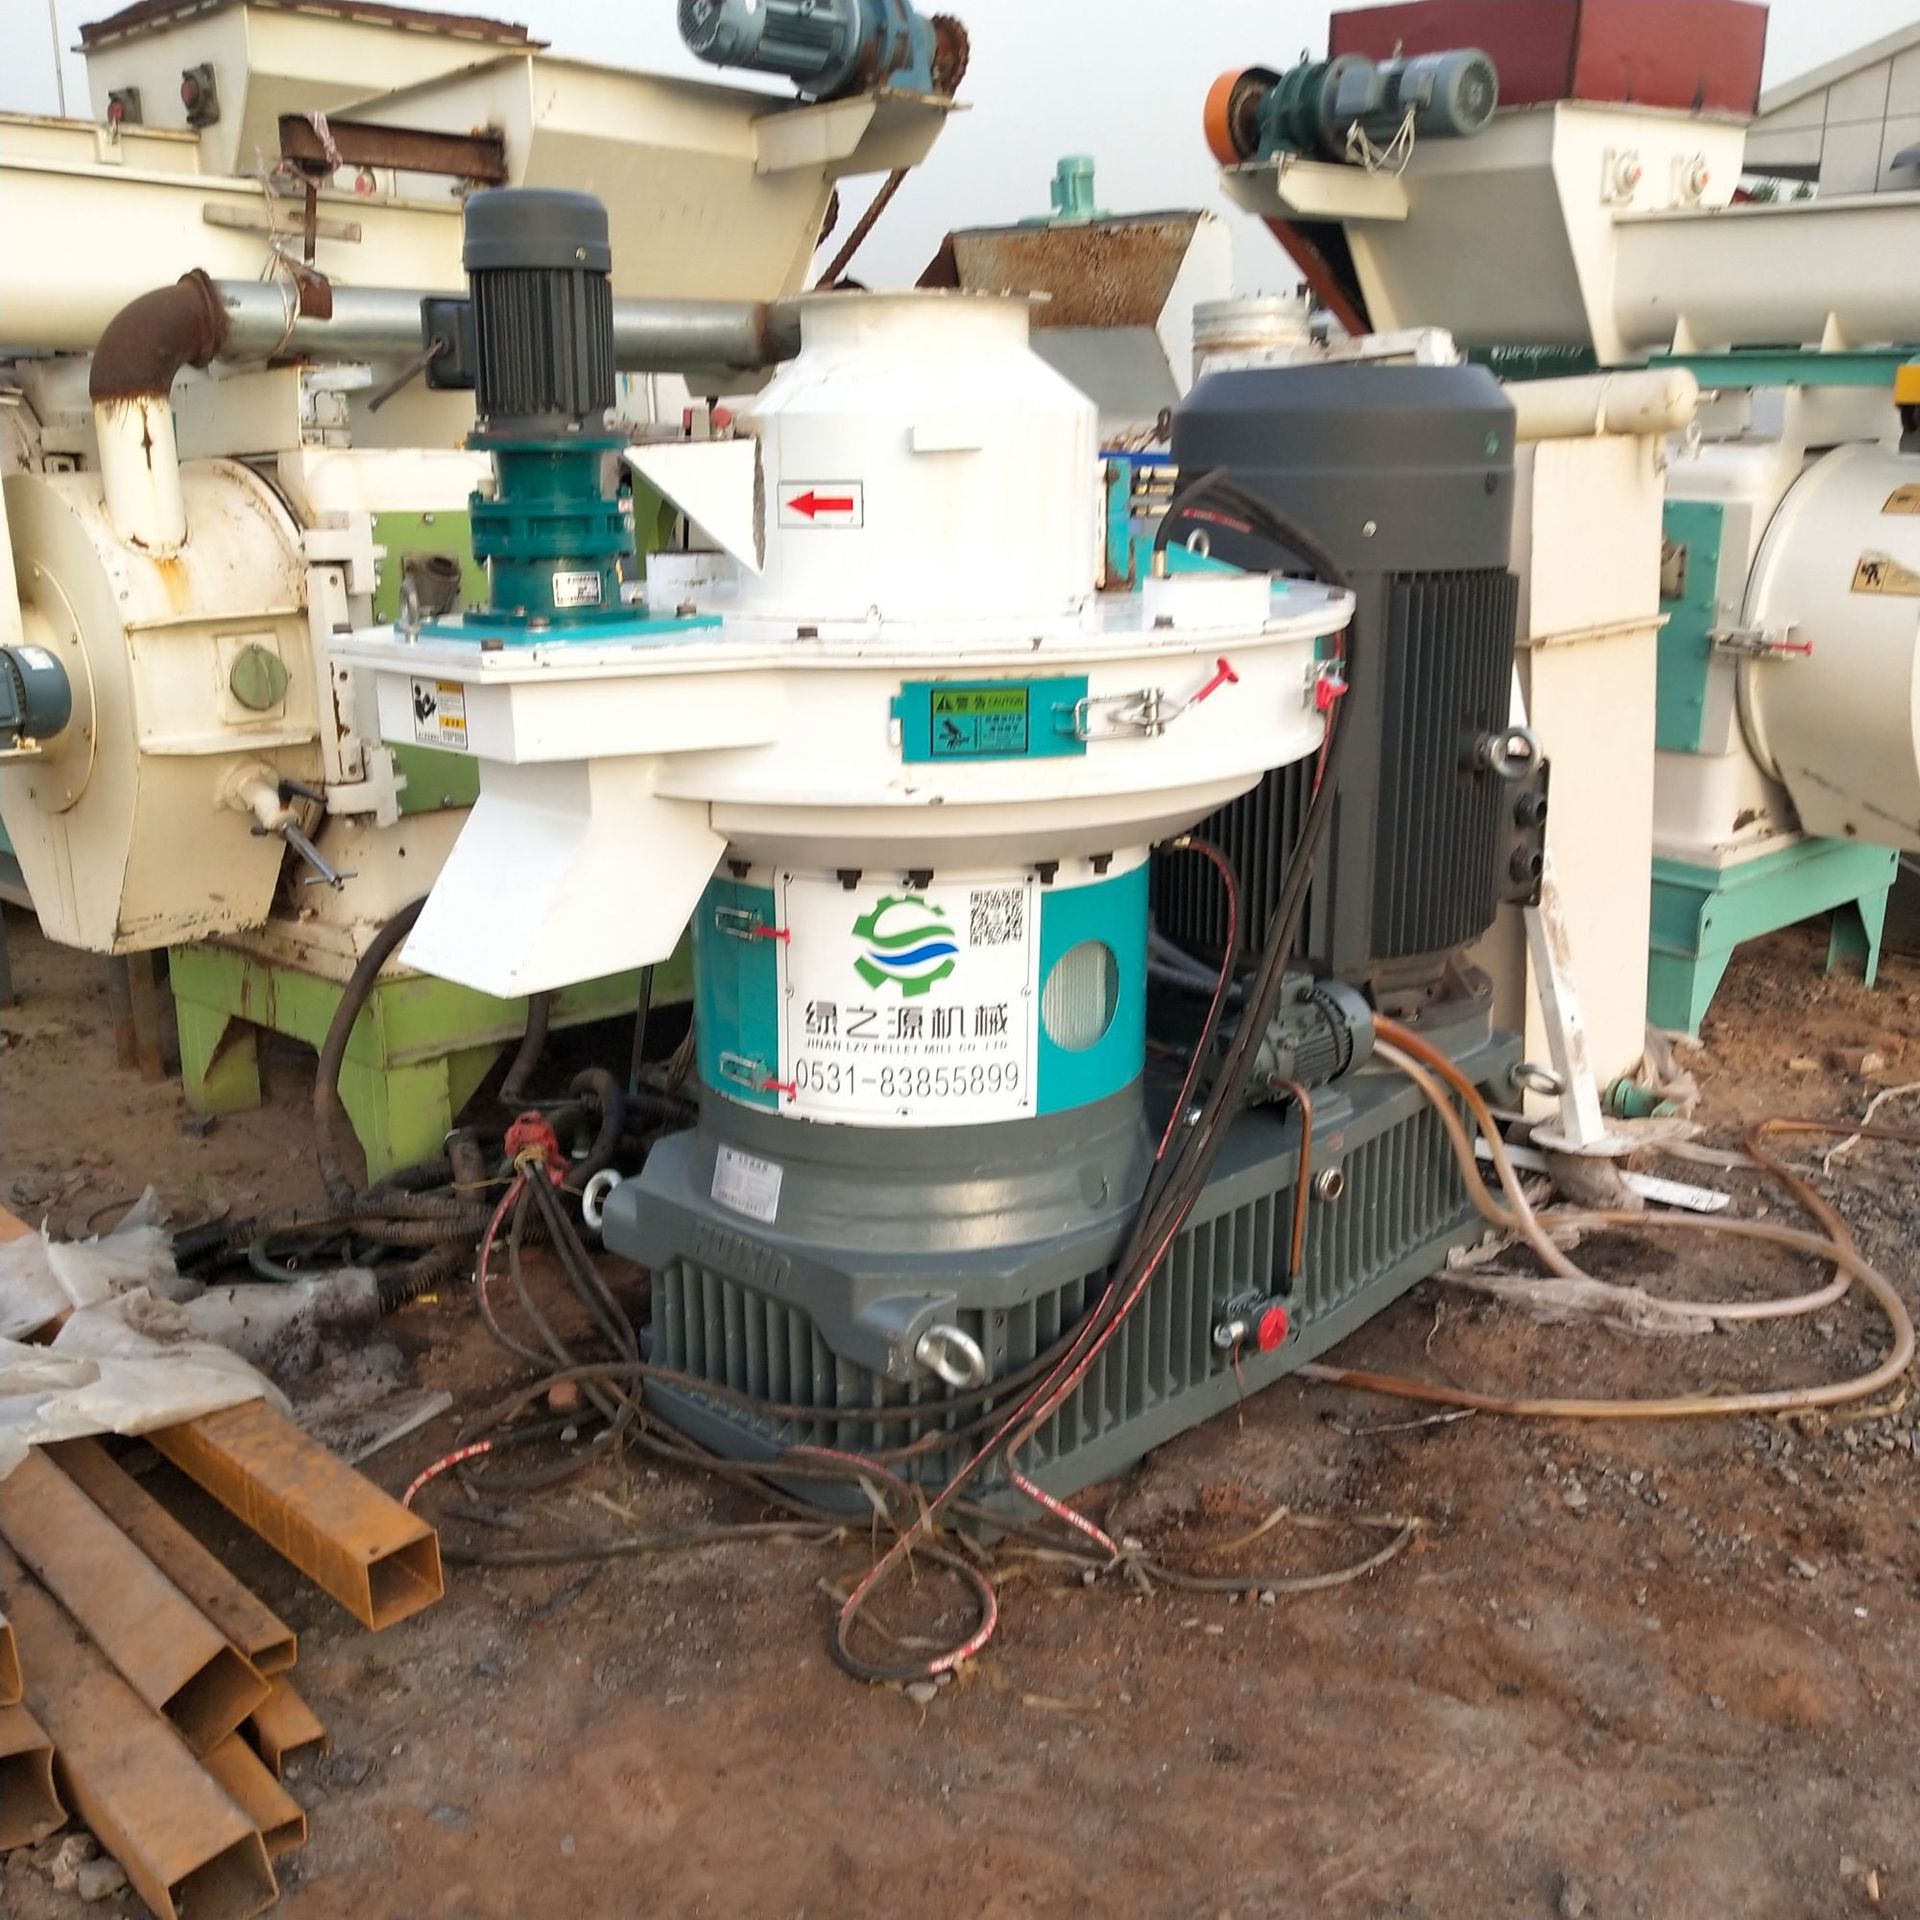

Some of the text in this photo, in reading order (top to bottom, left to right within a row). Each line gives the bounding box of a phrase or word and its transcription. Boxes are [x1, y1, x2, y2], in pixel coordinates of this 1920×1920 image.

[805, 1000, 1008, 1040] 绿之源机械
[806, 1037, 842, 1052] JINAN
[846, 1041, 869, 1053] LZY
[873, 1043, 919, 1056] PELLET
[924, 1043, 955, 1056] MILL
[795, 1057, 1019, 1098] 0531-83855899
